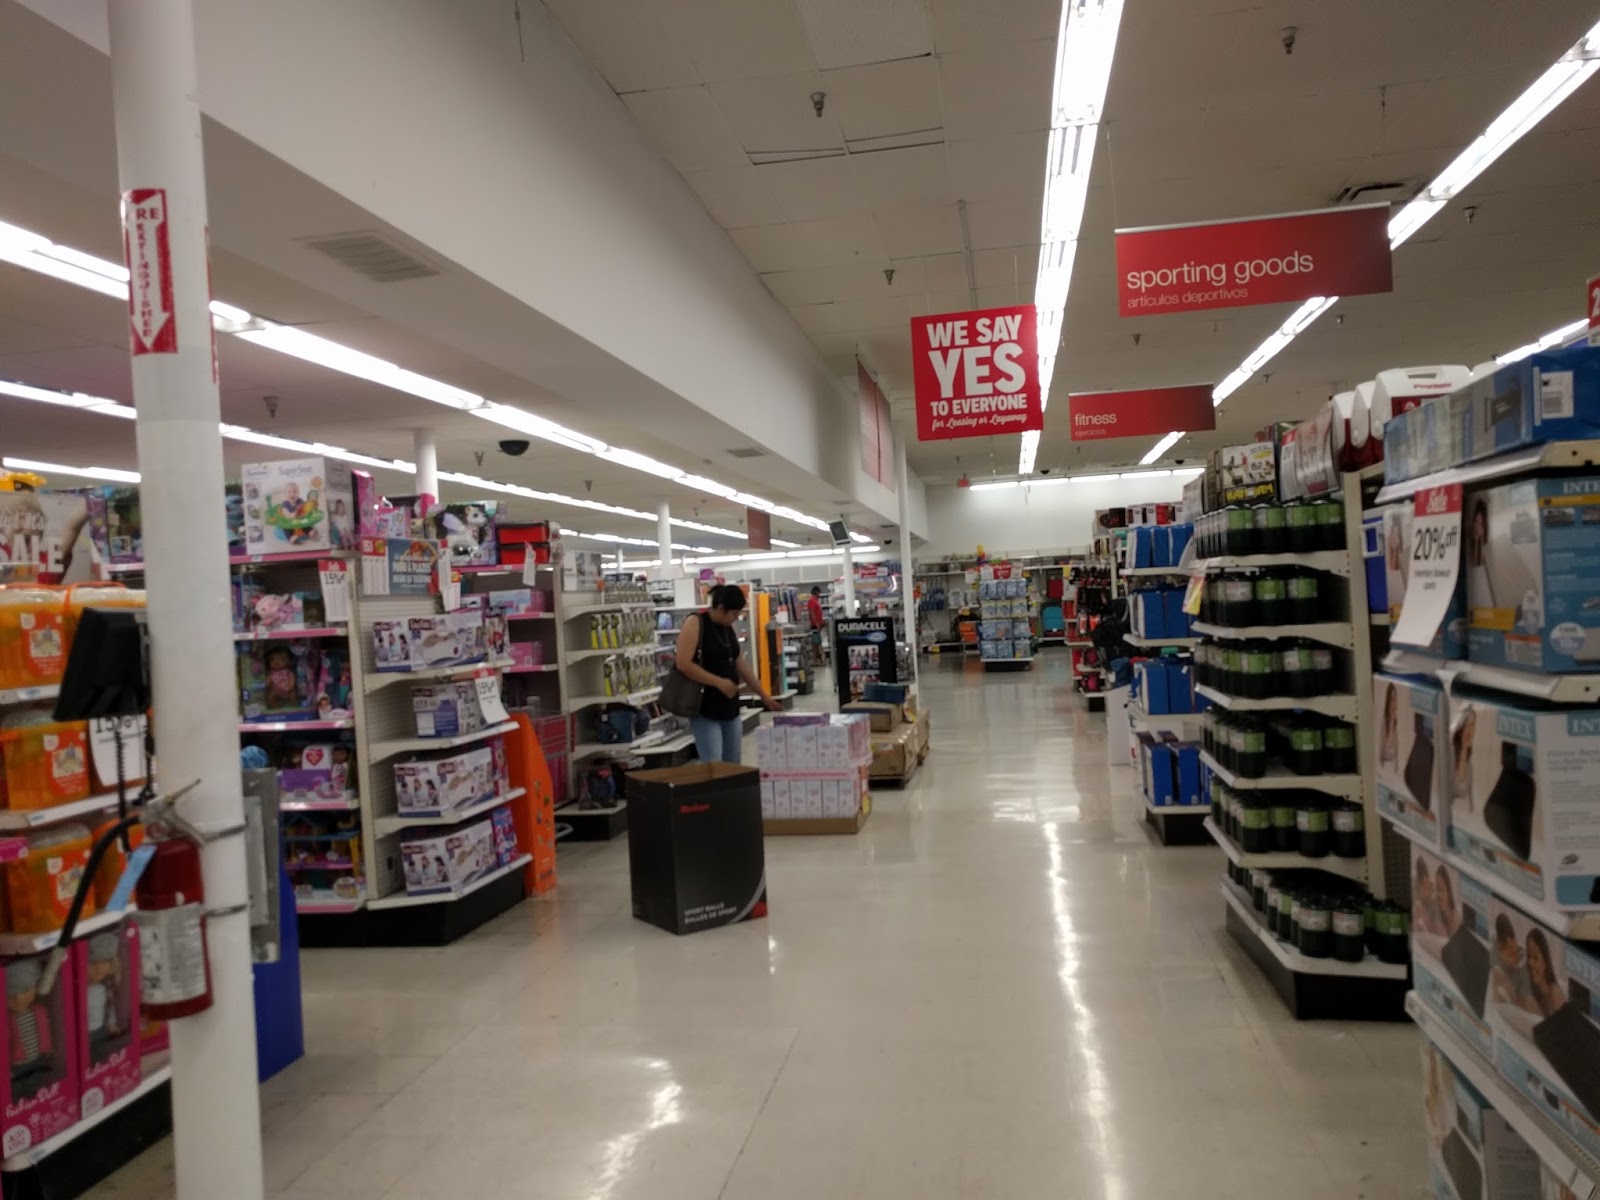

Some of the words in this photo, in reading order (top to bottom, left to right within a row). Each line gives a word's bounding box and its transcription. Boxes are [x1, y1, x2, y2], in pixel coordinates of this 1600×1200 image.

[1127, 261, 1226, 292] sporting
[1234, 250, 1314, 284] goods
[1182, 287, 1248, 306] deportivos
[926, 320, 969, 348] WE
[976, 314, 1022, 344] SAY
[928, 342, 1026, 398] YES
[930, 400, 949, 417] TO
[952, 393, 1027, 415] EVERYONE
[931, 419, 944, 432] for
[946, 416, 977, 429] Leasing
[989, 413, 1027, 426] Layaway
[1074, 413, 1117, 426] fitness
[1426, 487, 1448, 513] Sale
[1414, 526, 1447, 560] 20%
[838, 621, 887, 632] DURACELL
